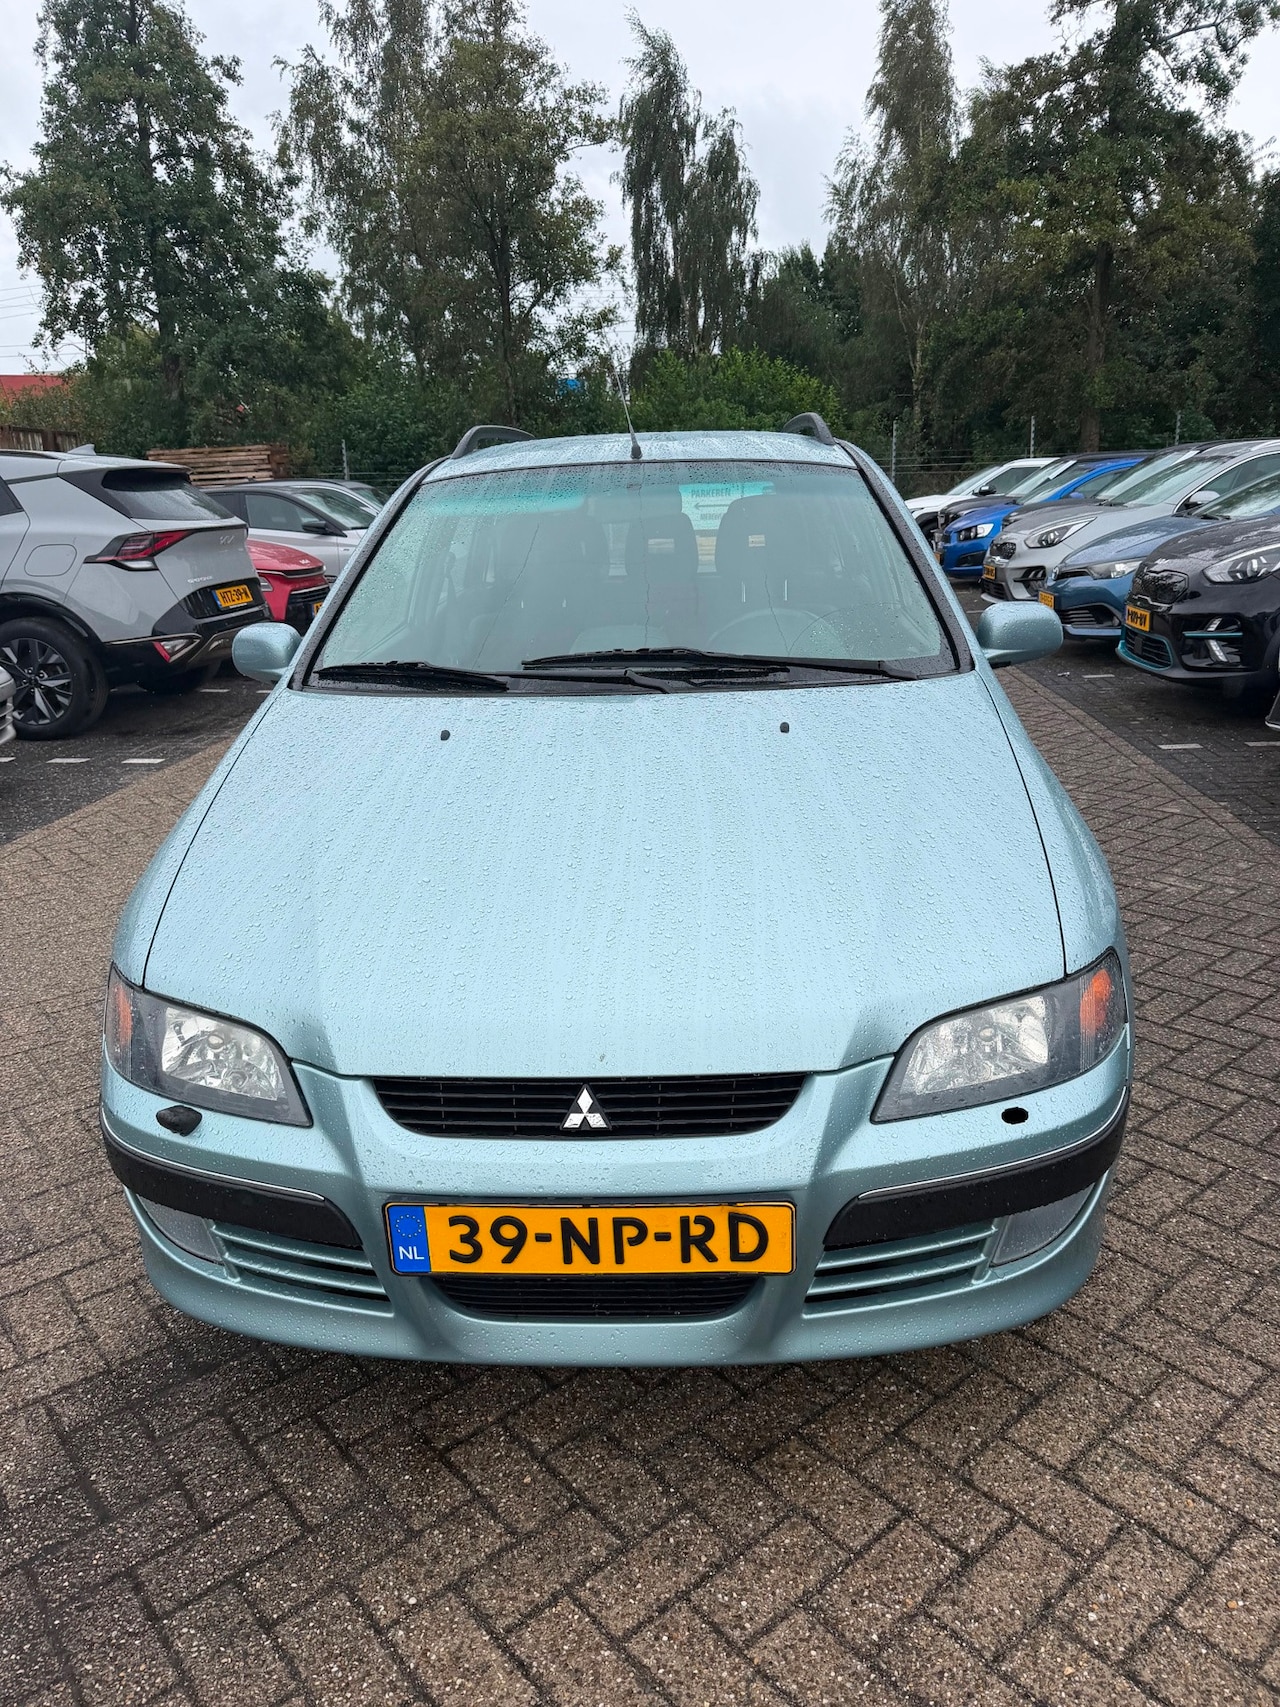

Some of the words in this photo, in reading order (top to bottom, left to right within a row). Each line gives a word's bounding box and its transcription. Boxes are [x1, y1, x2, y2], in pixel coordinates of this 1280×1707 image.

[691, 488, 731, 498] PARKEREN
[448, 1212, 769, 1264] 39-NP-RD
[398, 1245, 425, 1260] NL
